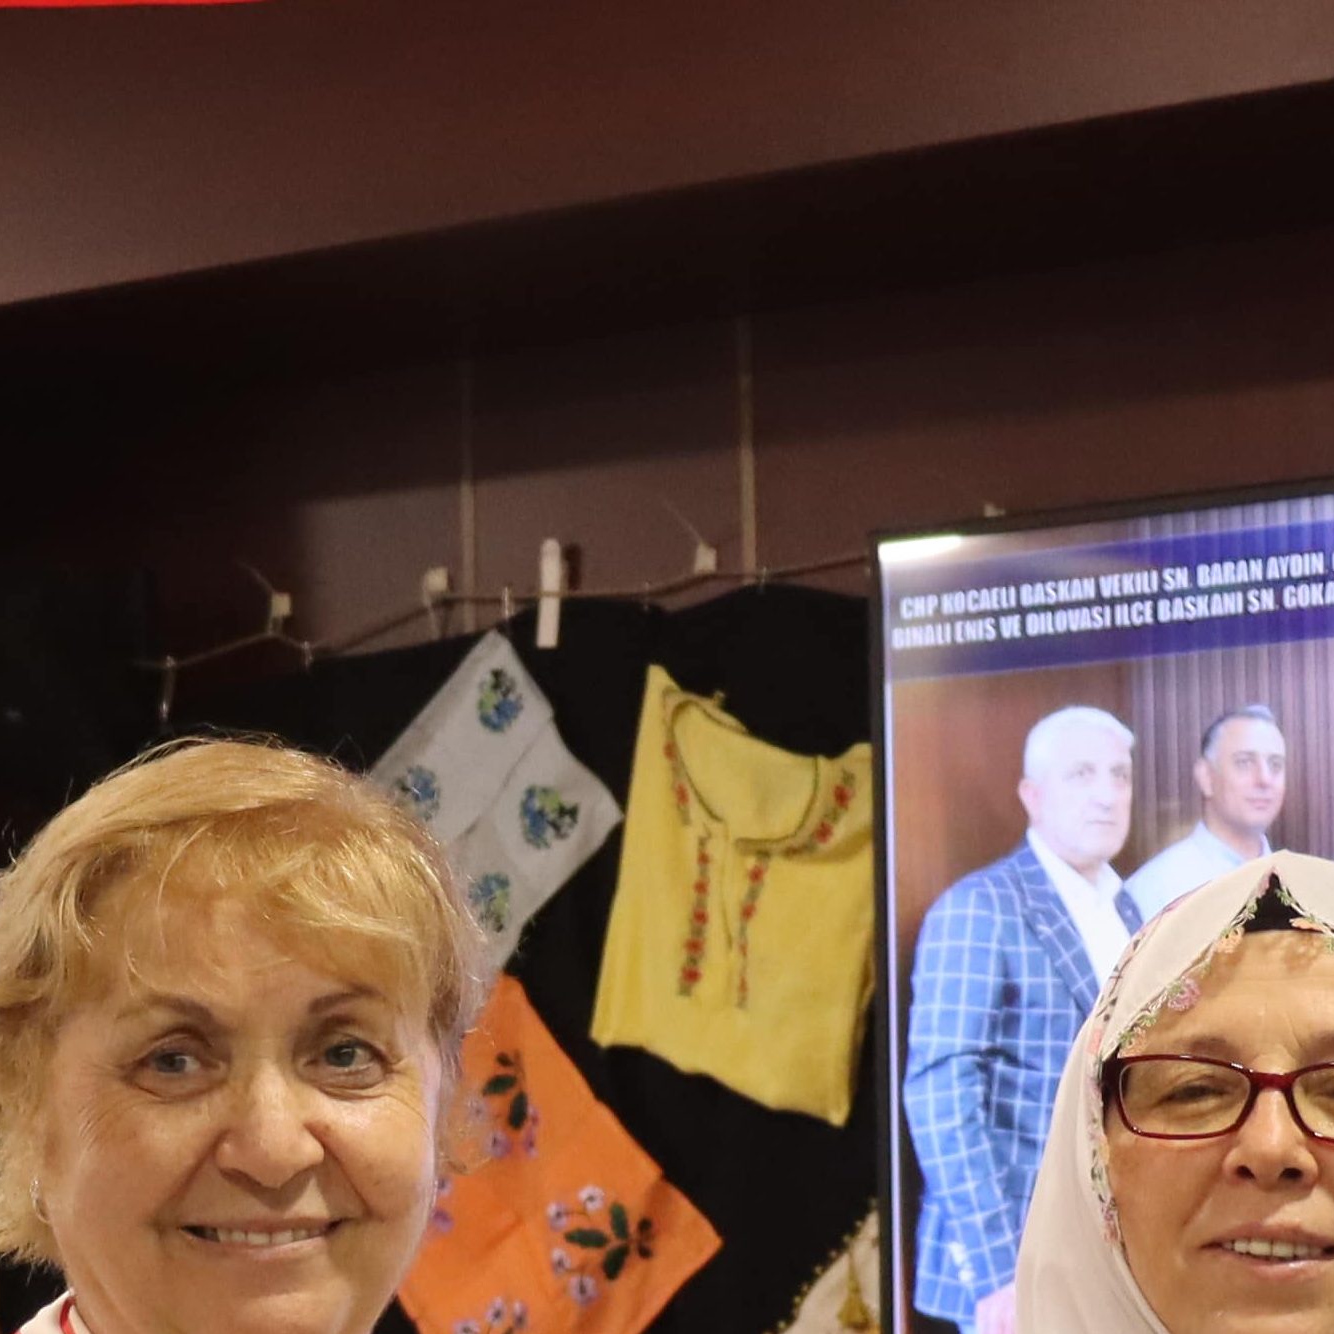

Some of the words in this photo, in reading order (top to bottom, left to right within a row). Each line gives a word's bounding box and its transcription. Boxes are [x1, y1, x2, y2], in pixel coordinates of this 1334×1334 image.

[900, 594, 937, 620] CHP
[1196, 558, 1263, 588] BARAN
[999, 614, 1022, 640] VE
